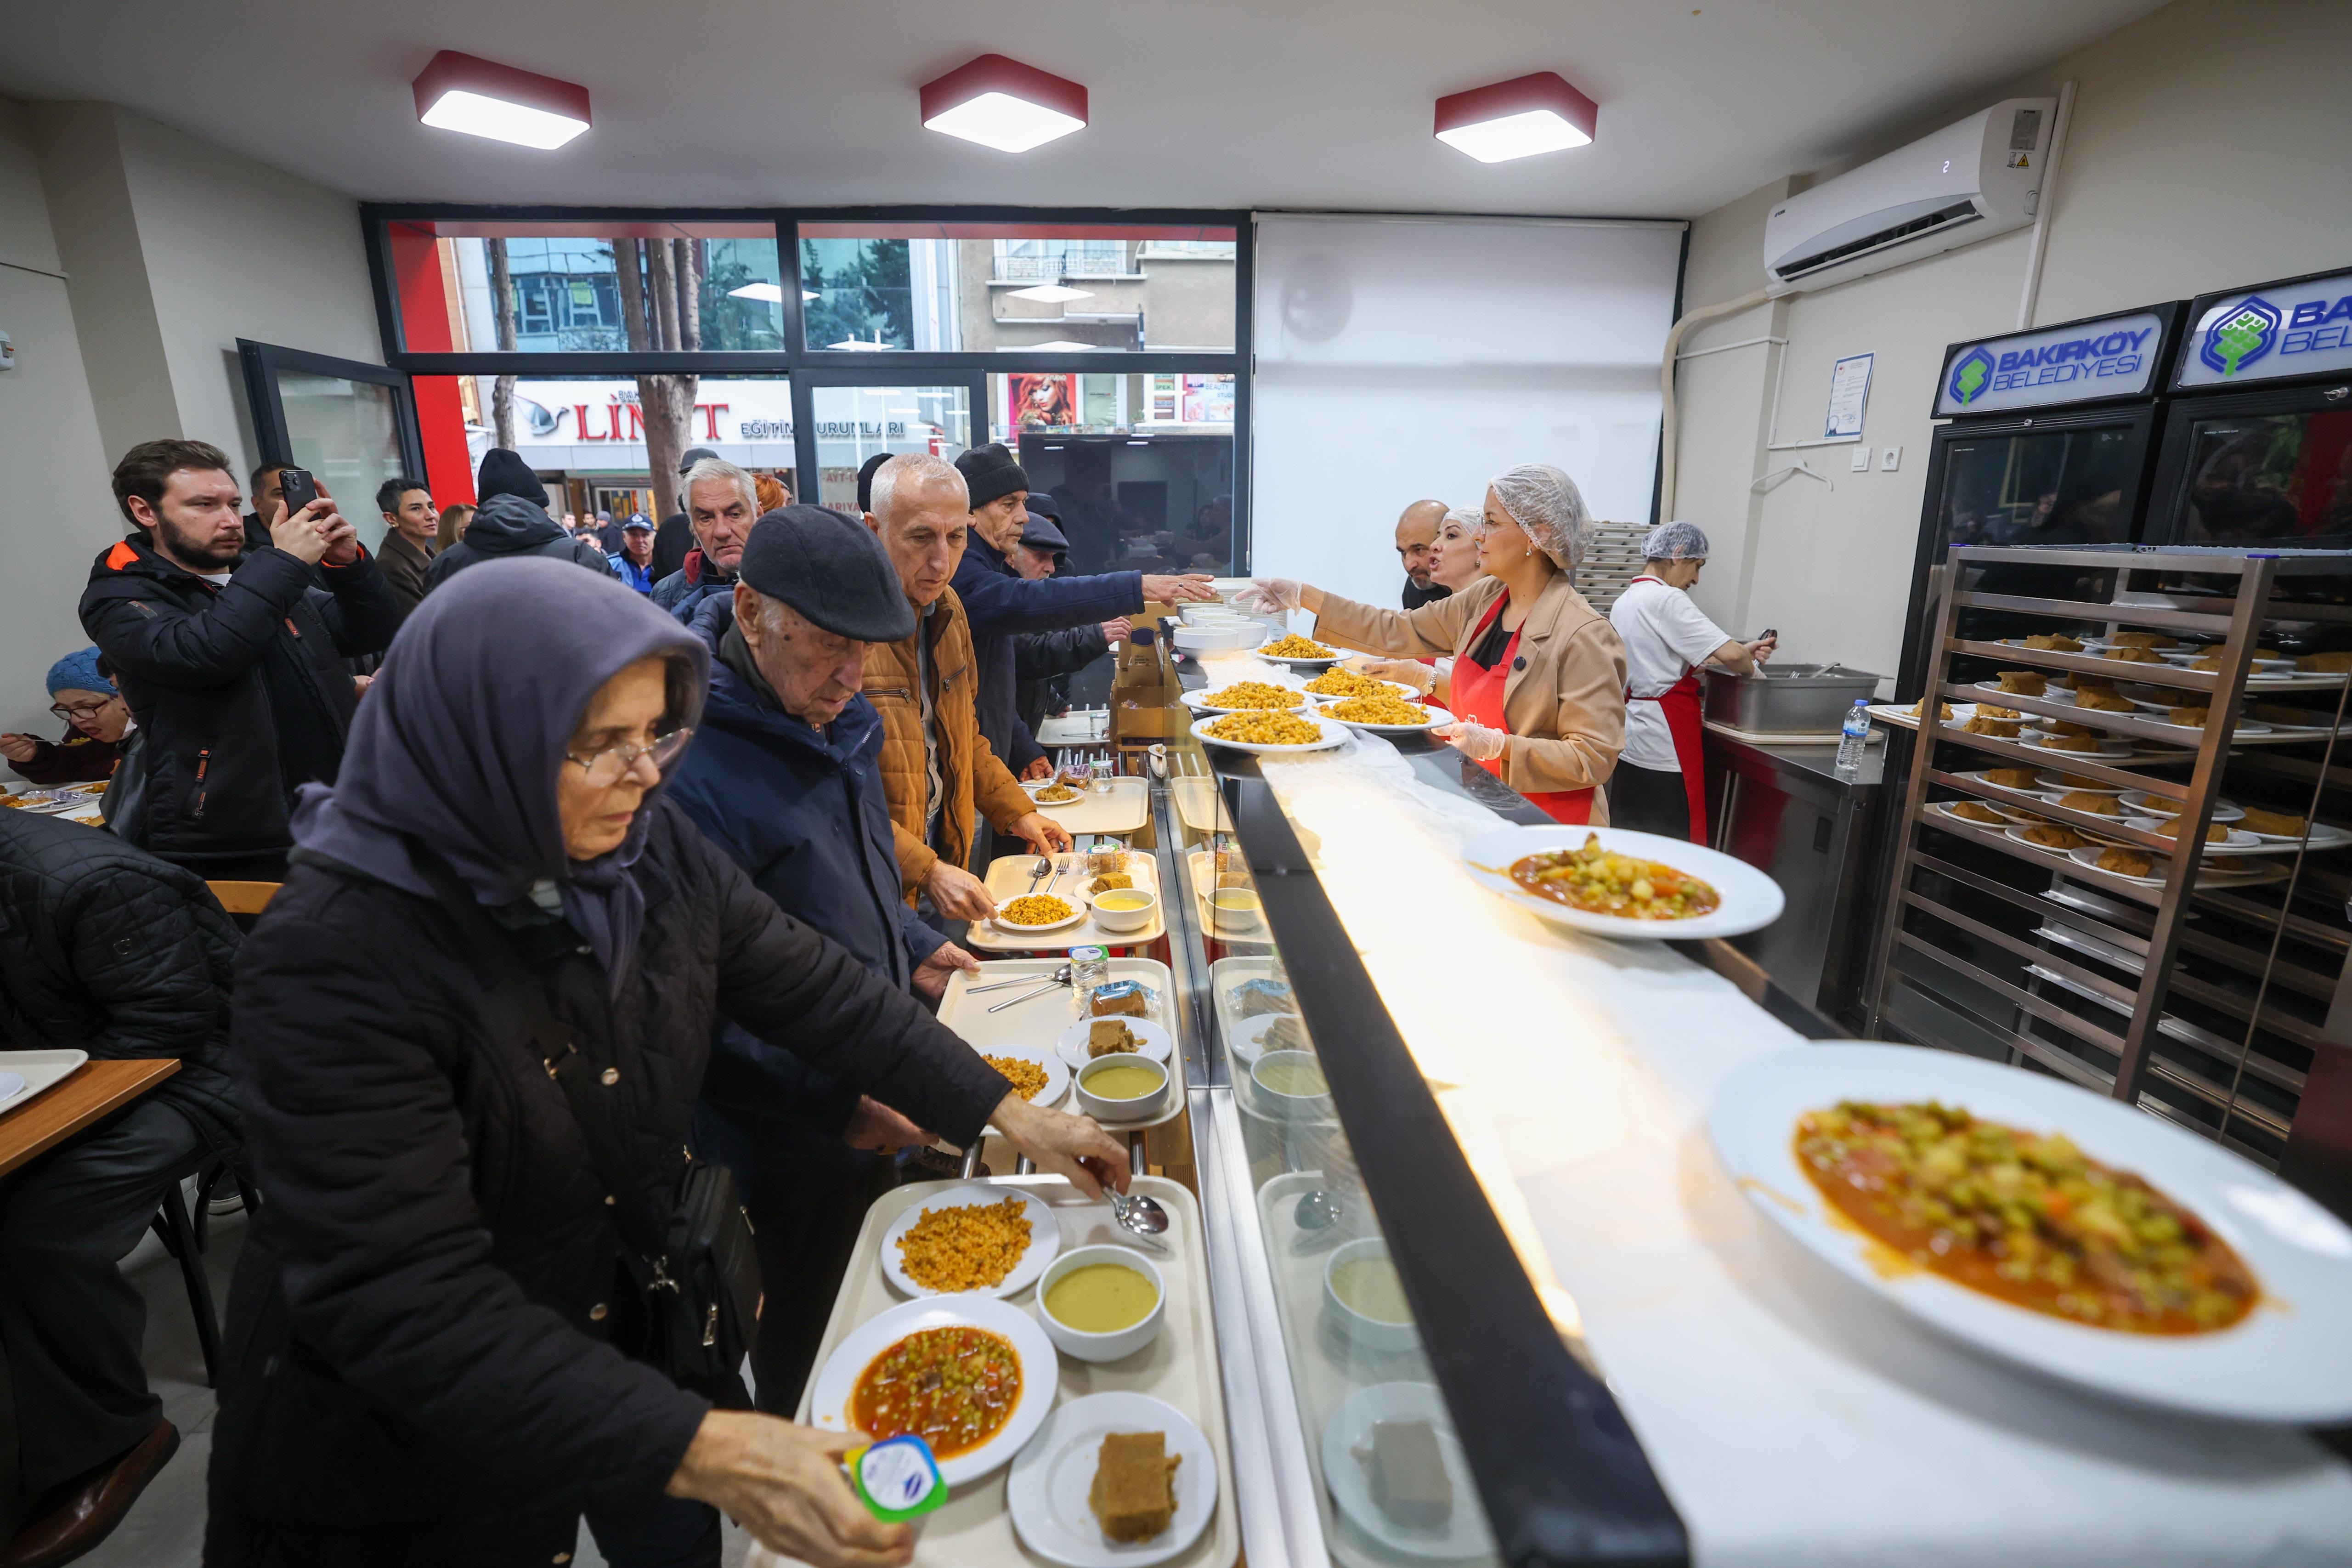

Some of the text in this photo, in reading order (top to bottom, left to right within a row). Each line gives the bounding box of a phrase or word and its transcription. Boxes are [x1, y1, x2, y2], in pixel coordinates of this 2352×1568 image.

[1943, 160, 1950, 173] 2
[2288, 295, 2352, 329] BA
[1997, 327, 2153, 373] BAKIRKÖY
[2279, 325, 2352, 355] BEL
[1992, 353, 2143, 391] BELEDİYESİ
[816, 421, 905, 435] URUMLARI
